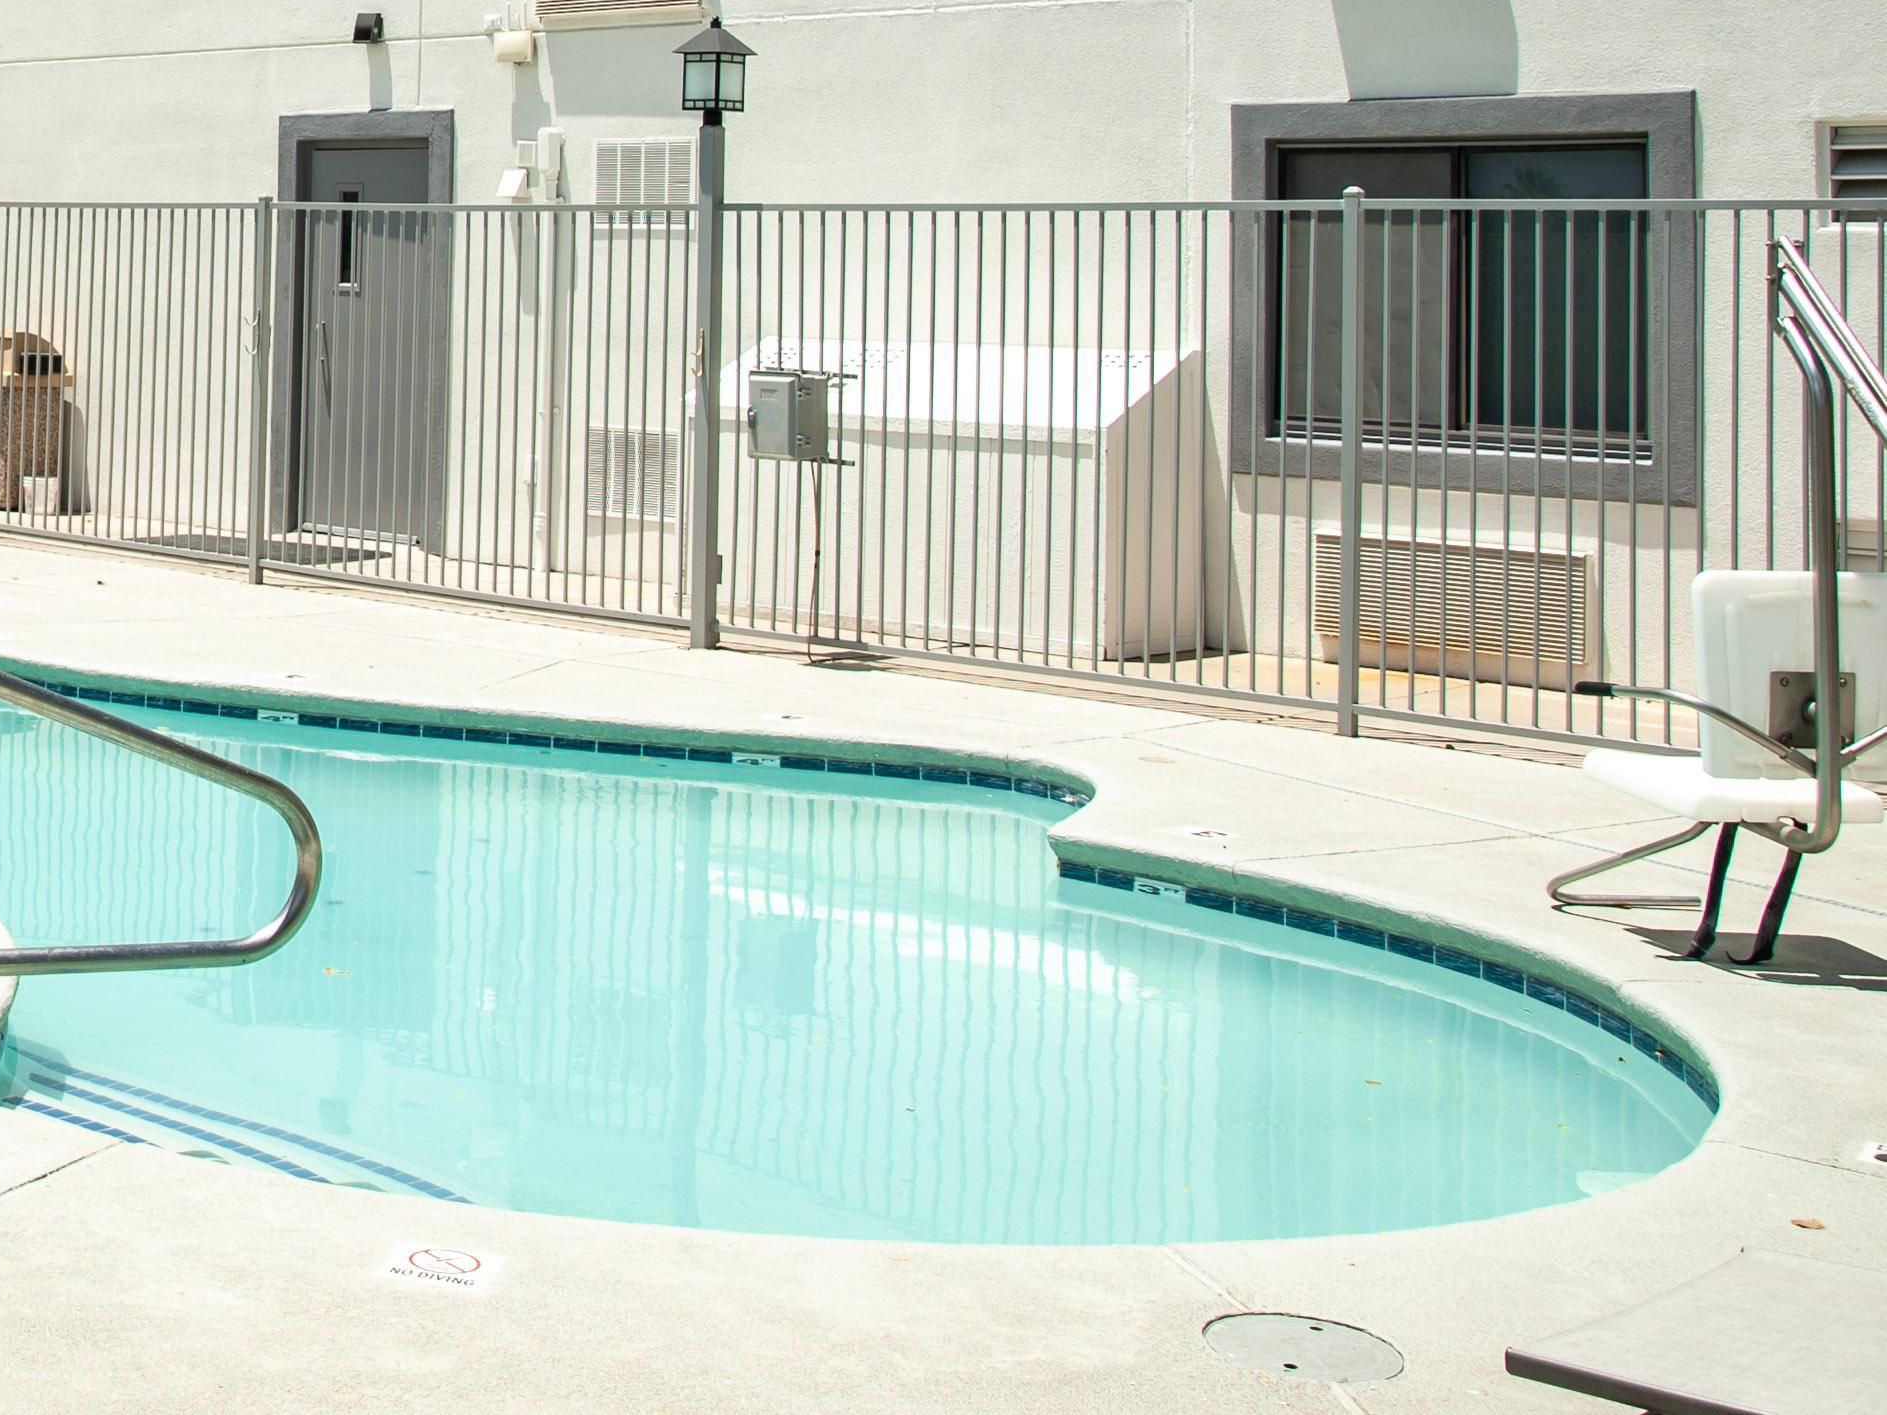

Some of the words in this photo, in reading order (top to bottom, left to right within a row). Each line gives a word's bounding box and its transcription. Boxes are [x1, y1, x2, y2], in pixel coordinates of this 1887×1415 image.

[1138, 883, 1161, 896] 3
[389, 1266, 413, 1276] NO
[417, 1271, 476, 1286] DIVING
